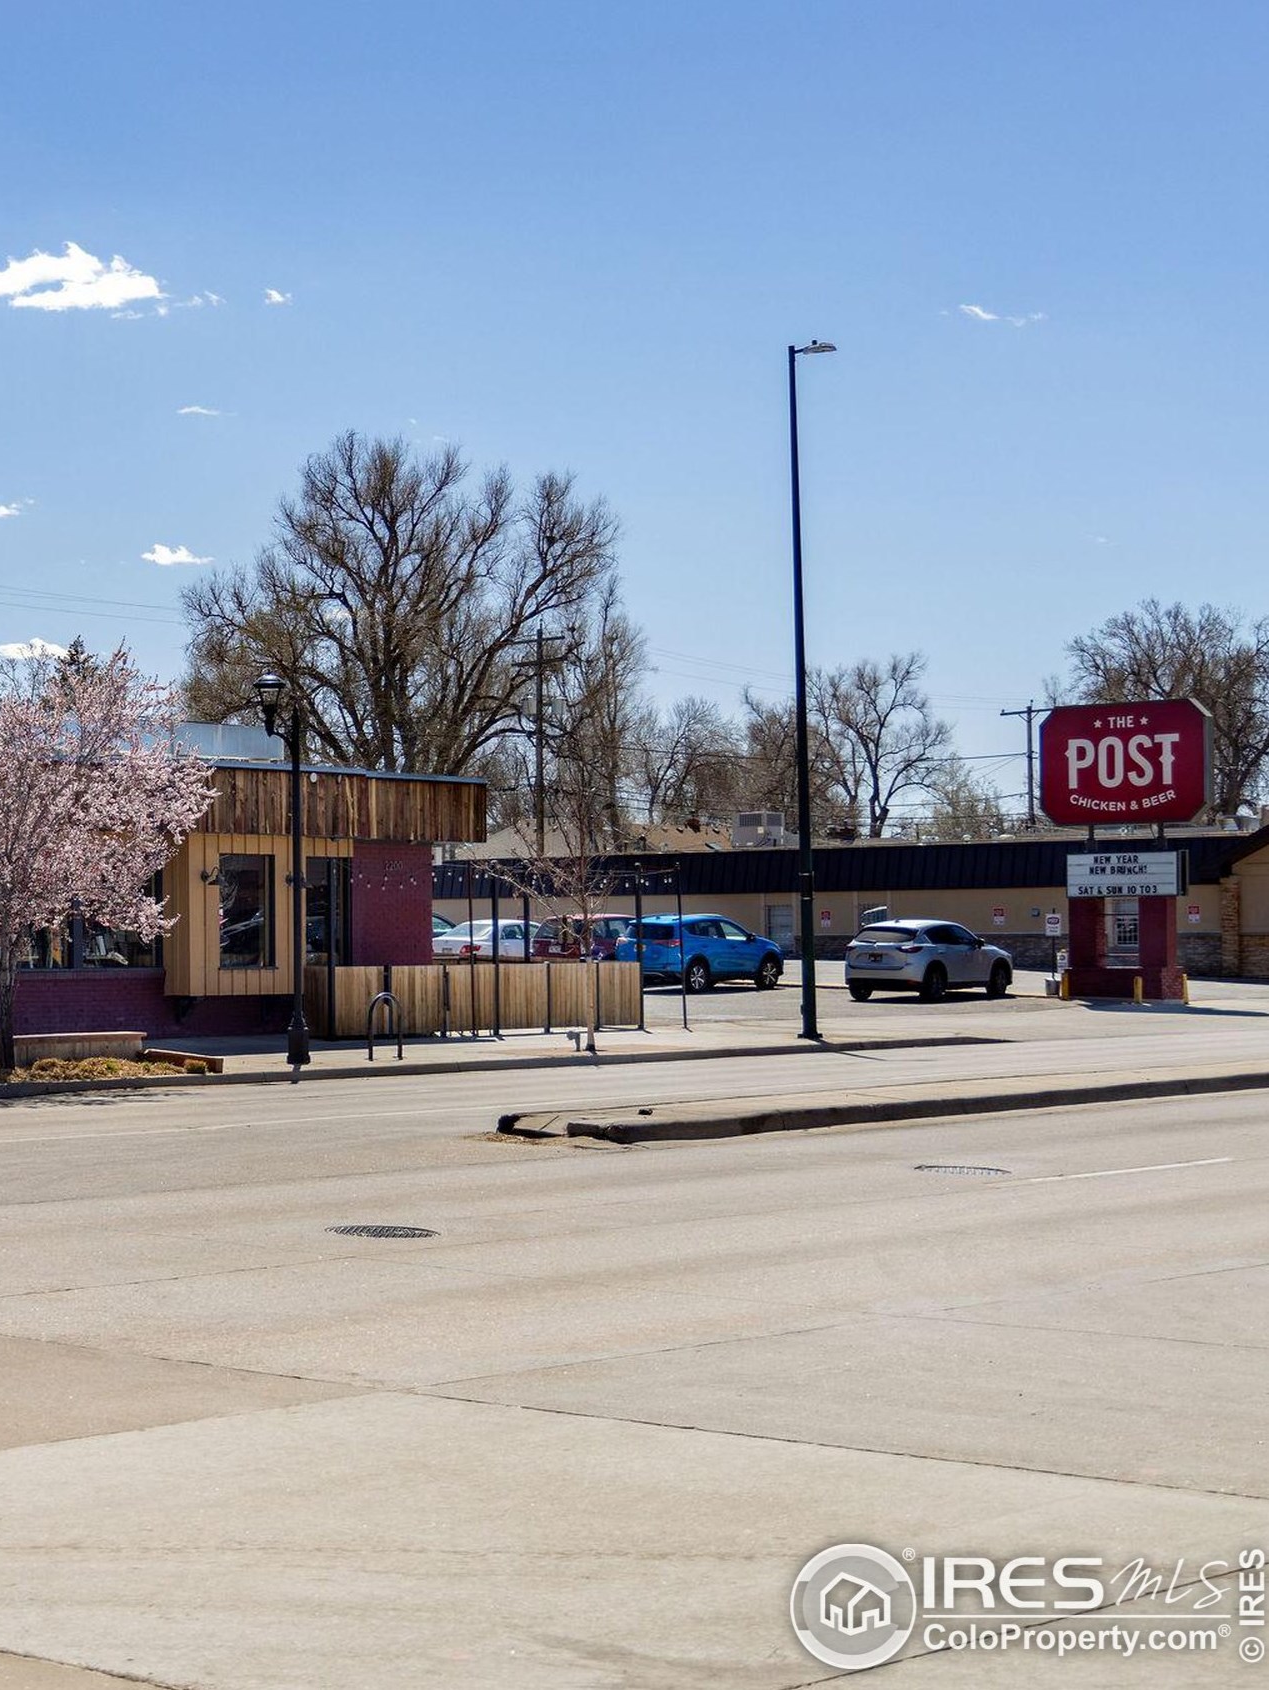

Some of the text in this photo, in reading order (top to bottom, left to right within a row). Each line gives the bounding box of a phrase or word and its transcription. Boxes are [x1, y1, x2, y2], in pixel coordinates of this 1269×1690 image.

[1107, 716, 1135, 729] THE
[1065, 733, 1180, 789] POST
[1069, 789, 1177, 811] CHICKEN & BEER
[1093, 855, 1139, 864] NEW YEAR
[1089, 865, 1147, 875] NEW BRUNCH!
[1078, 886, 1093, 895] SAT
[1097, 886, 1103, 894] &
[1106, 886, 1123, 894] SUN
[1127, 886, 1137, 894] 10
